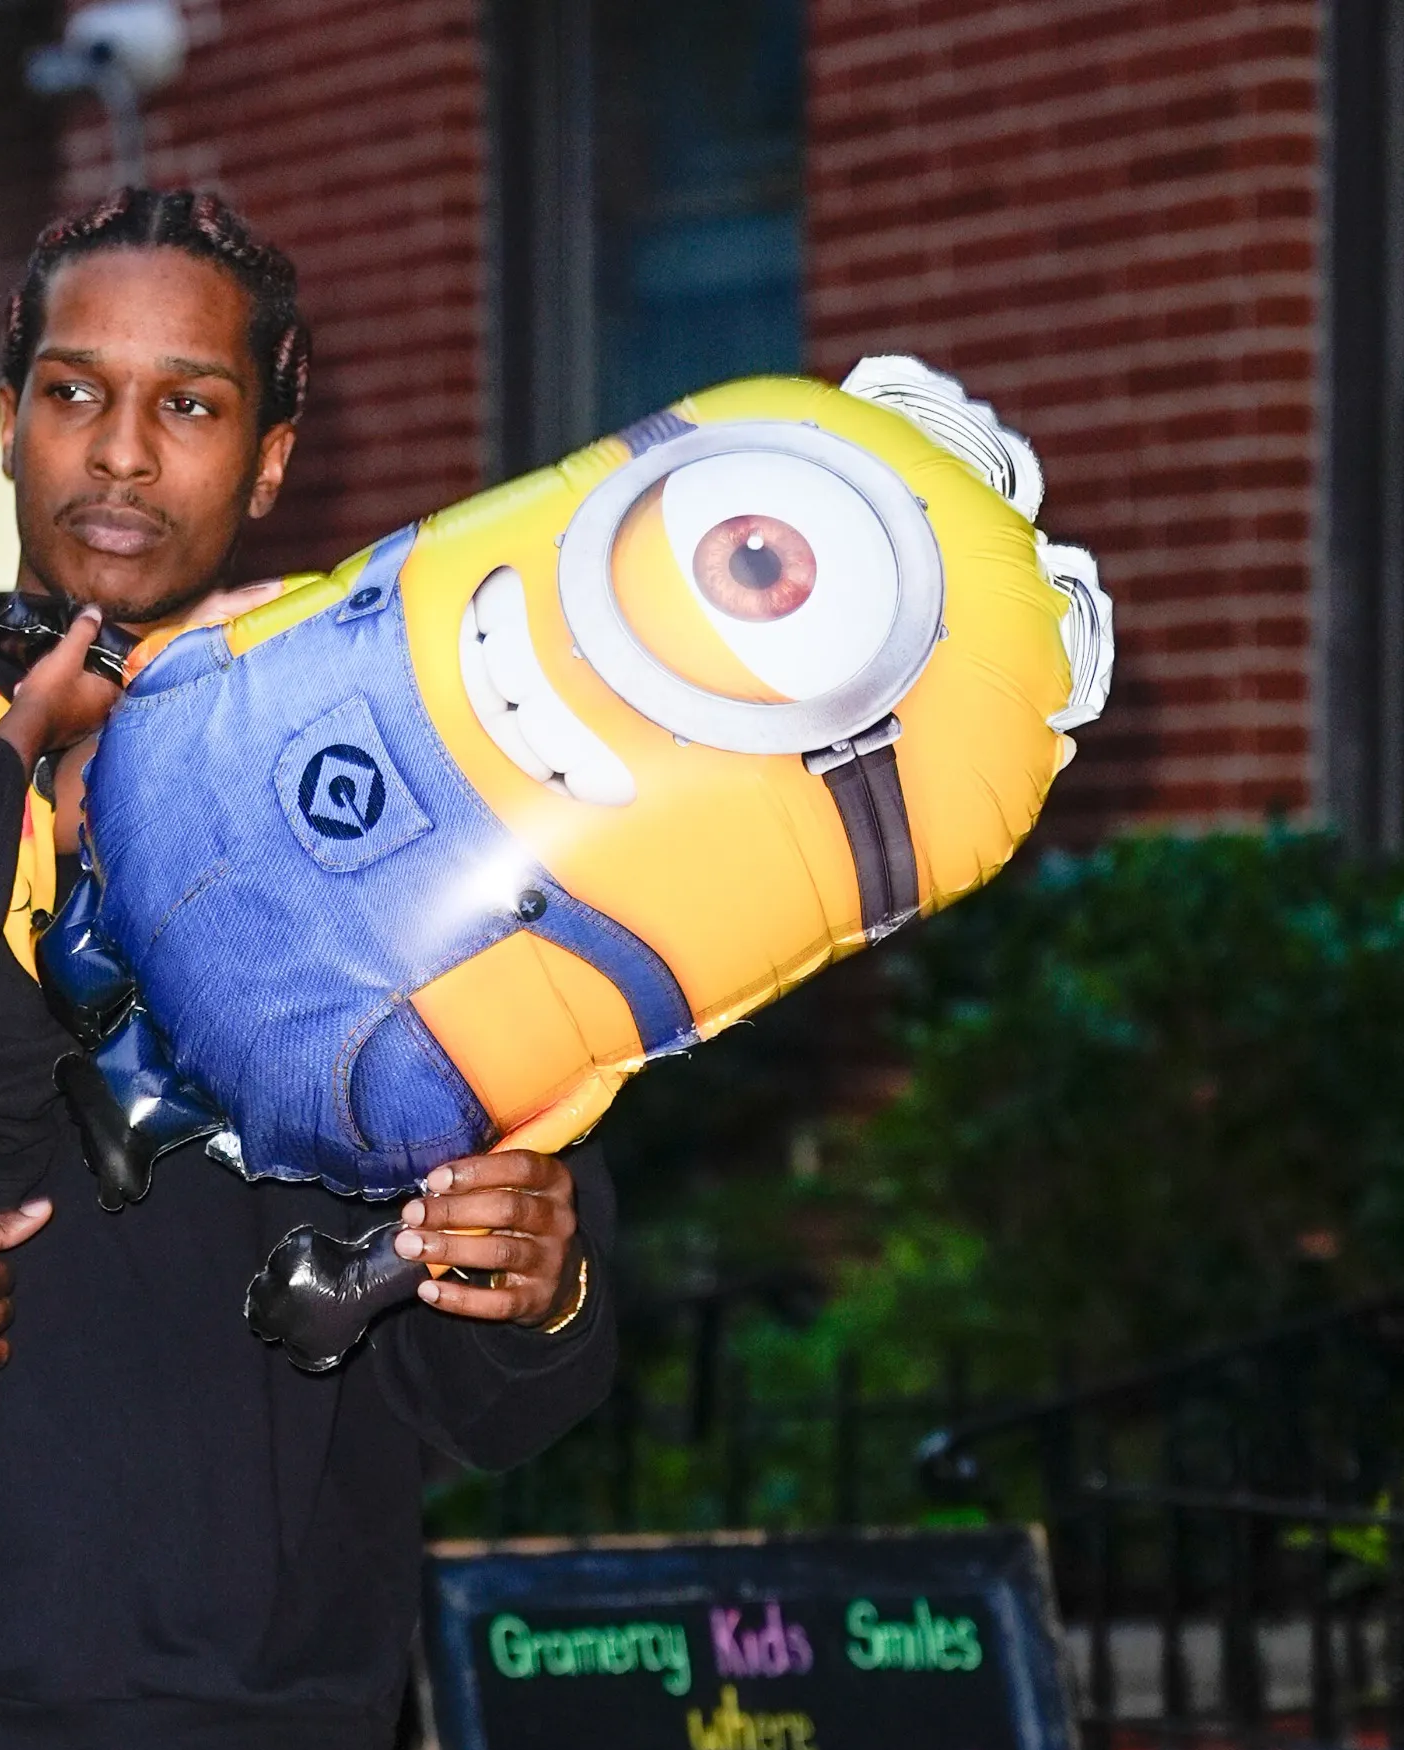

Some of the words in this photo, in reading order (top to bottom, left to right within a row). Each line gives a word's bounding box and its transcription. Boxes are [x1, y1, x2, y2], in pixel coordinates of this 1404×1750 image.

[489, 1612, 692, 1696] Gramercy
[709, 1599, 815, 1678] Kids
[845, 1596, 983, 1671] Smiles
